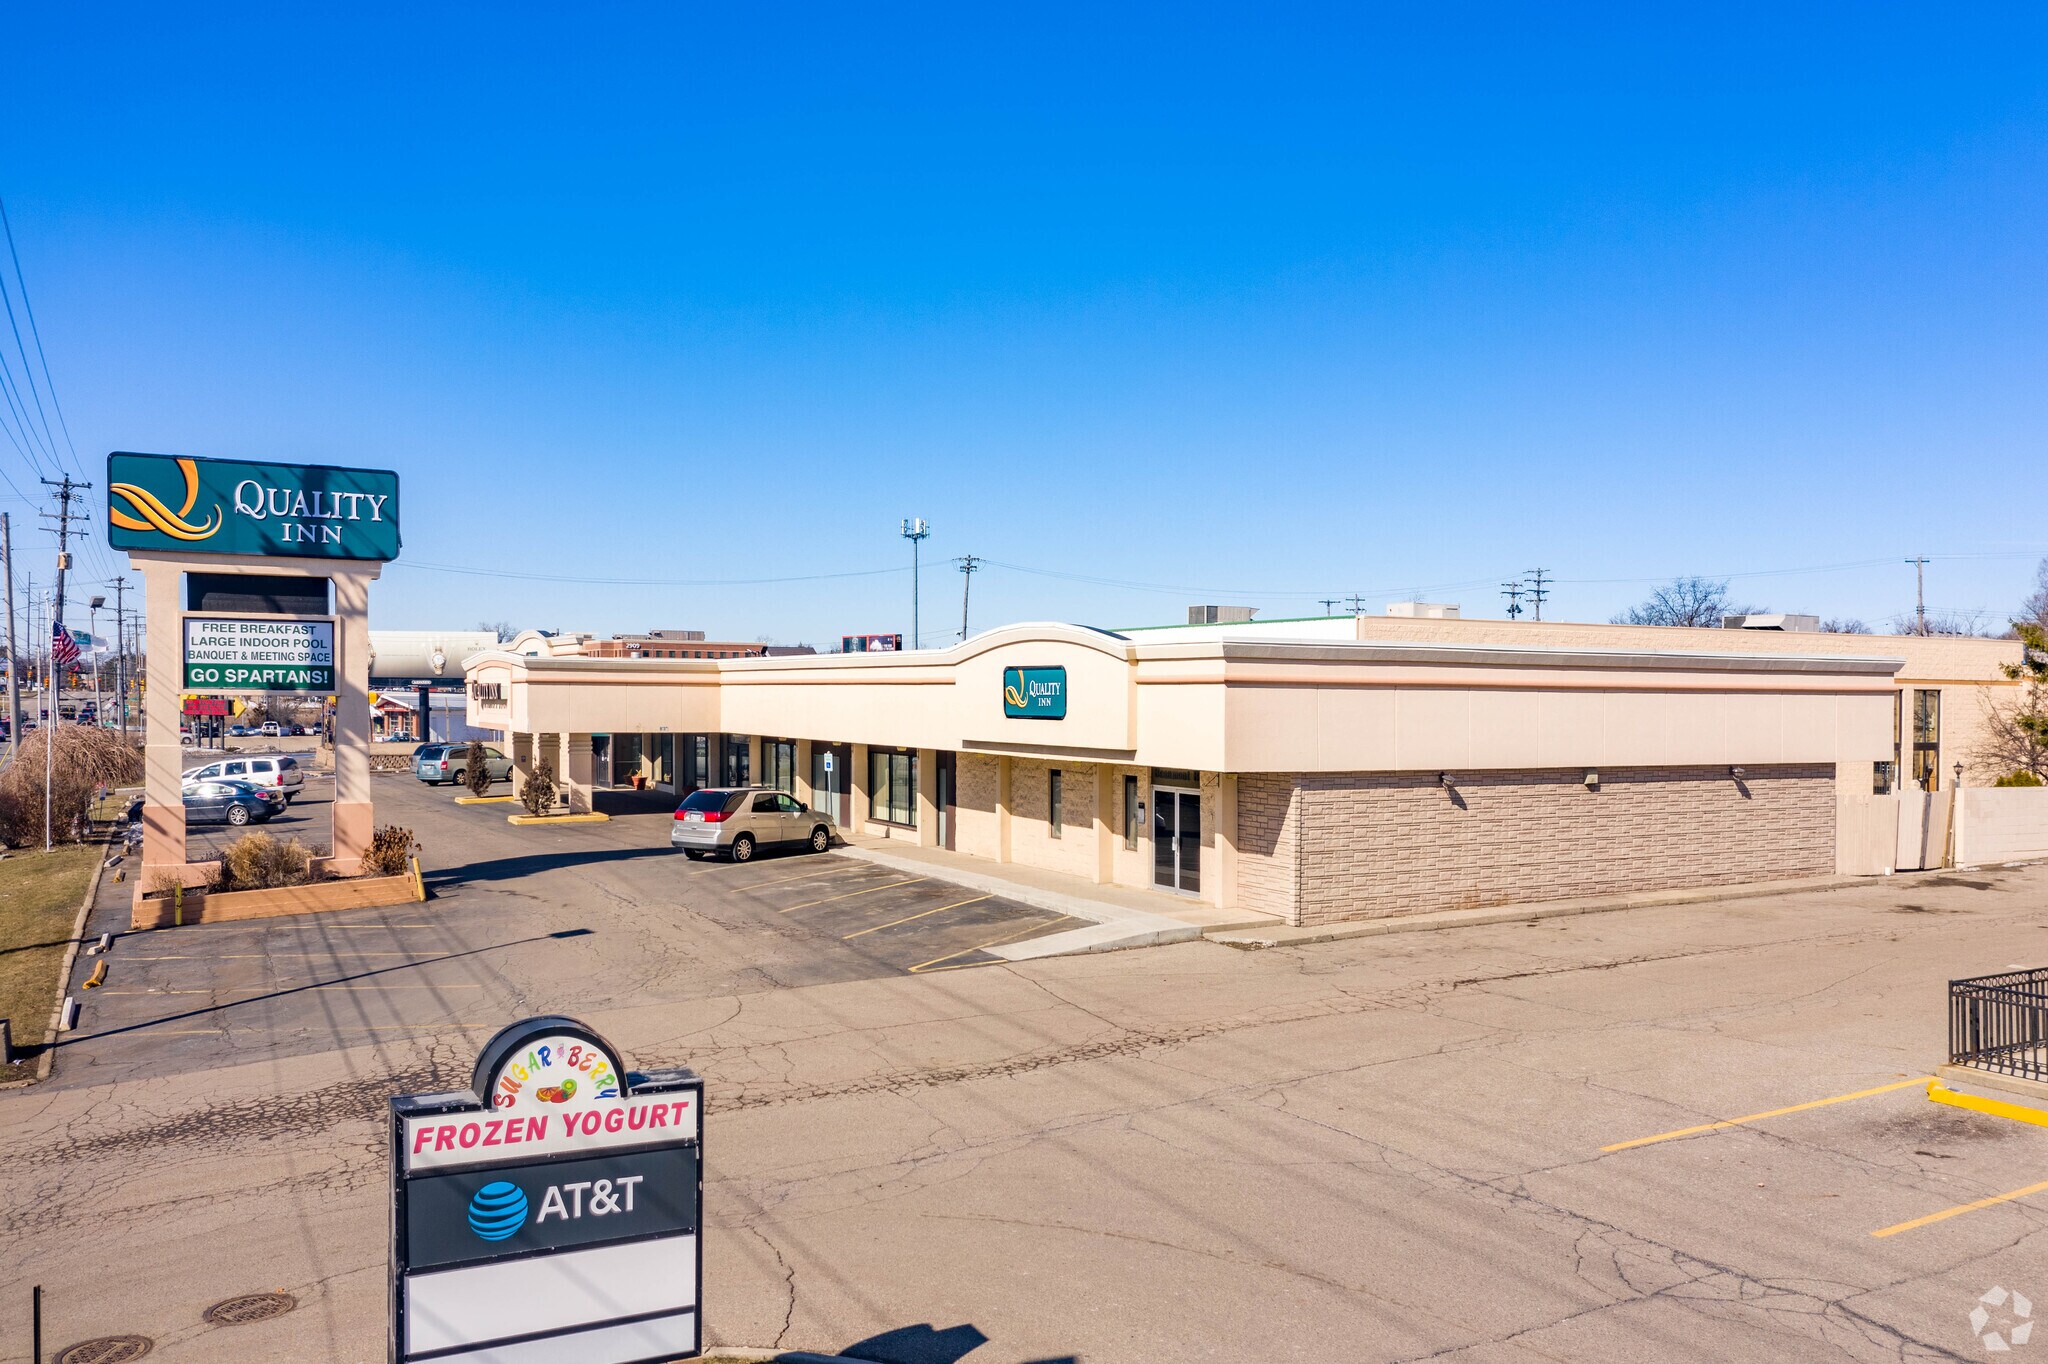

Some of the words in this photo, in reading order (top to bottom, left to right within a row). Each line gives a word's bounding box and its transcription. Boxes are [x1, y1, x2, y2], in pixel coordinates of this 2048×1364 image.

[234, 480, 388, 522] QUALITY
[281, 523, 342, 545] INN
[202, 623, 236, 633] FREE
[240, 623, 317, 635] BREAKFAST
[191, 637, 236, 647] LARGE
[239, 637, 290, 648] INDOOR
[293, 639, 328, 649] POOL
[188, 650, 239, 660] BANQUET
[241, 651, 248, 661] &
[250, 651, 295, 661] MEETING
[297, 652, 331, 662] SPACE
[190, 668, 220, 683] GO
[224, 669, 328, 684] SPARTANS!
[1029, 680, 1061, 697] QUALITY
[1038, 697, 1052, 707] INN
[493, 1045, 552, 1108] SUGAR
[413, 1115, 549, 1154] FROZEN
[562, 1101, 690, 1138] YOGURT
[536, 1175, 644, 1224] AT&T
